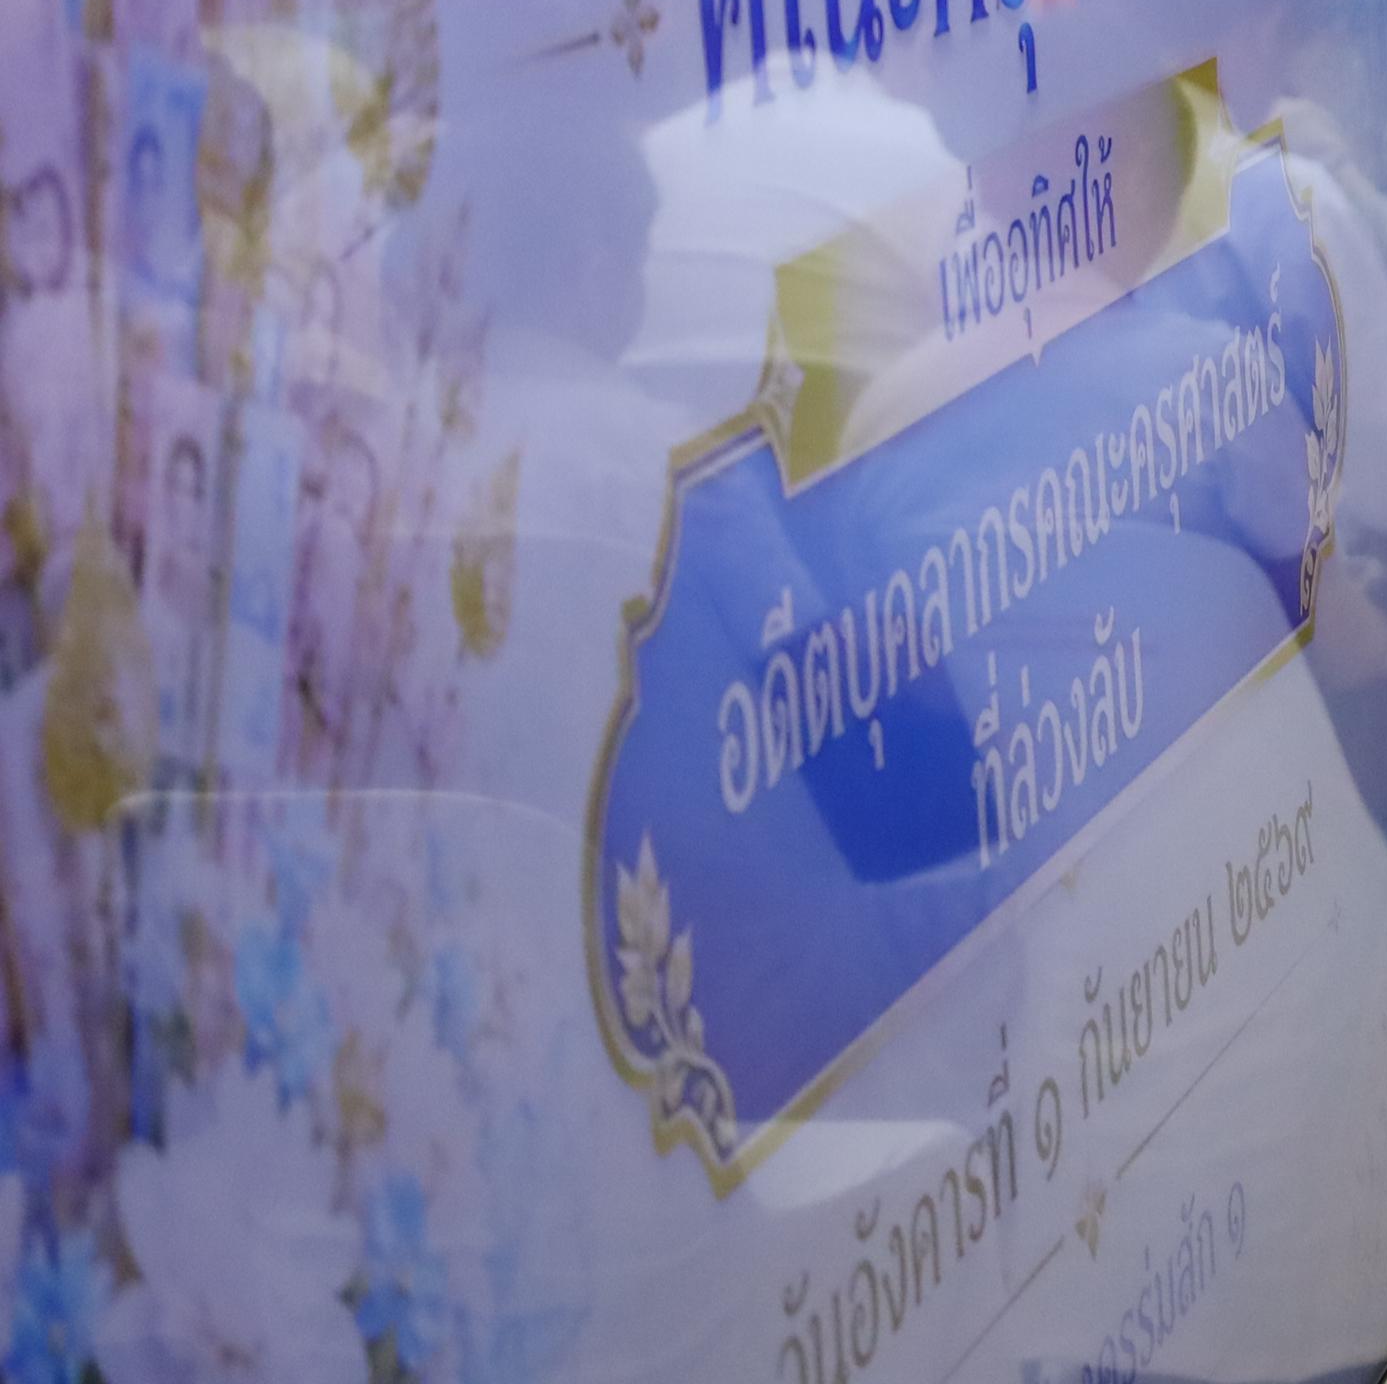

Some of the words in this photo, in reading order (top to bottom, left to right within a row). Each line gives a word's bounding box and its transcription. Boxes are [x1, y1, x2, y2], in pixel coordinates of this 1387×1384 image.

[938, 133, 1117, 342] เพื่ออุทิศให้
[718, 262, 1287, 814] อดีตบุคลากรคณะครุศาสตร์
[972, 606, 1144, 871] ที่ล่วงลับ
[1034, 1077, 1063, 1182] ๑
[1078, 895, 1218, 1119] กันยายน
[1226, 779, 1315, 946] ๒๕๖๙
